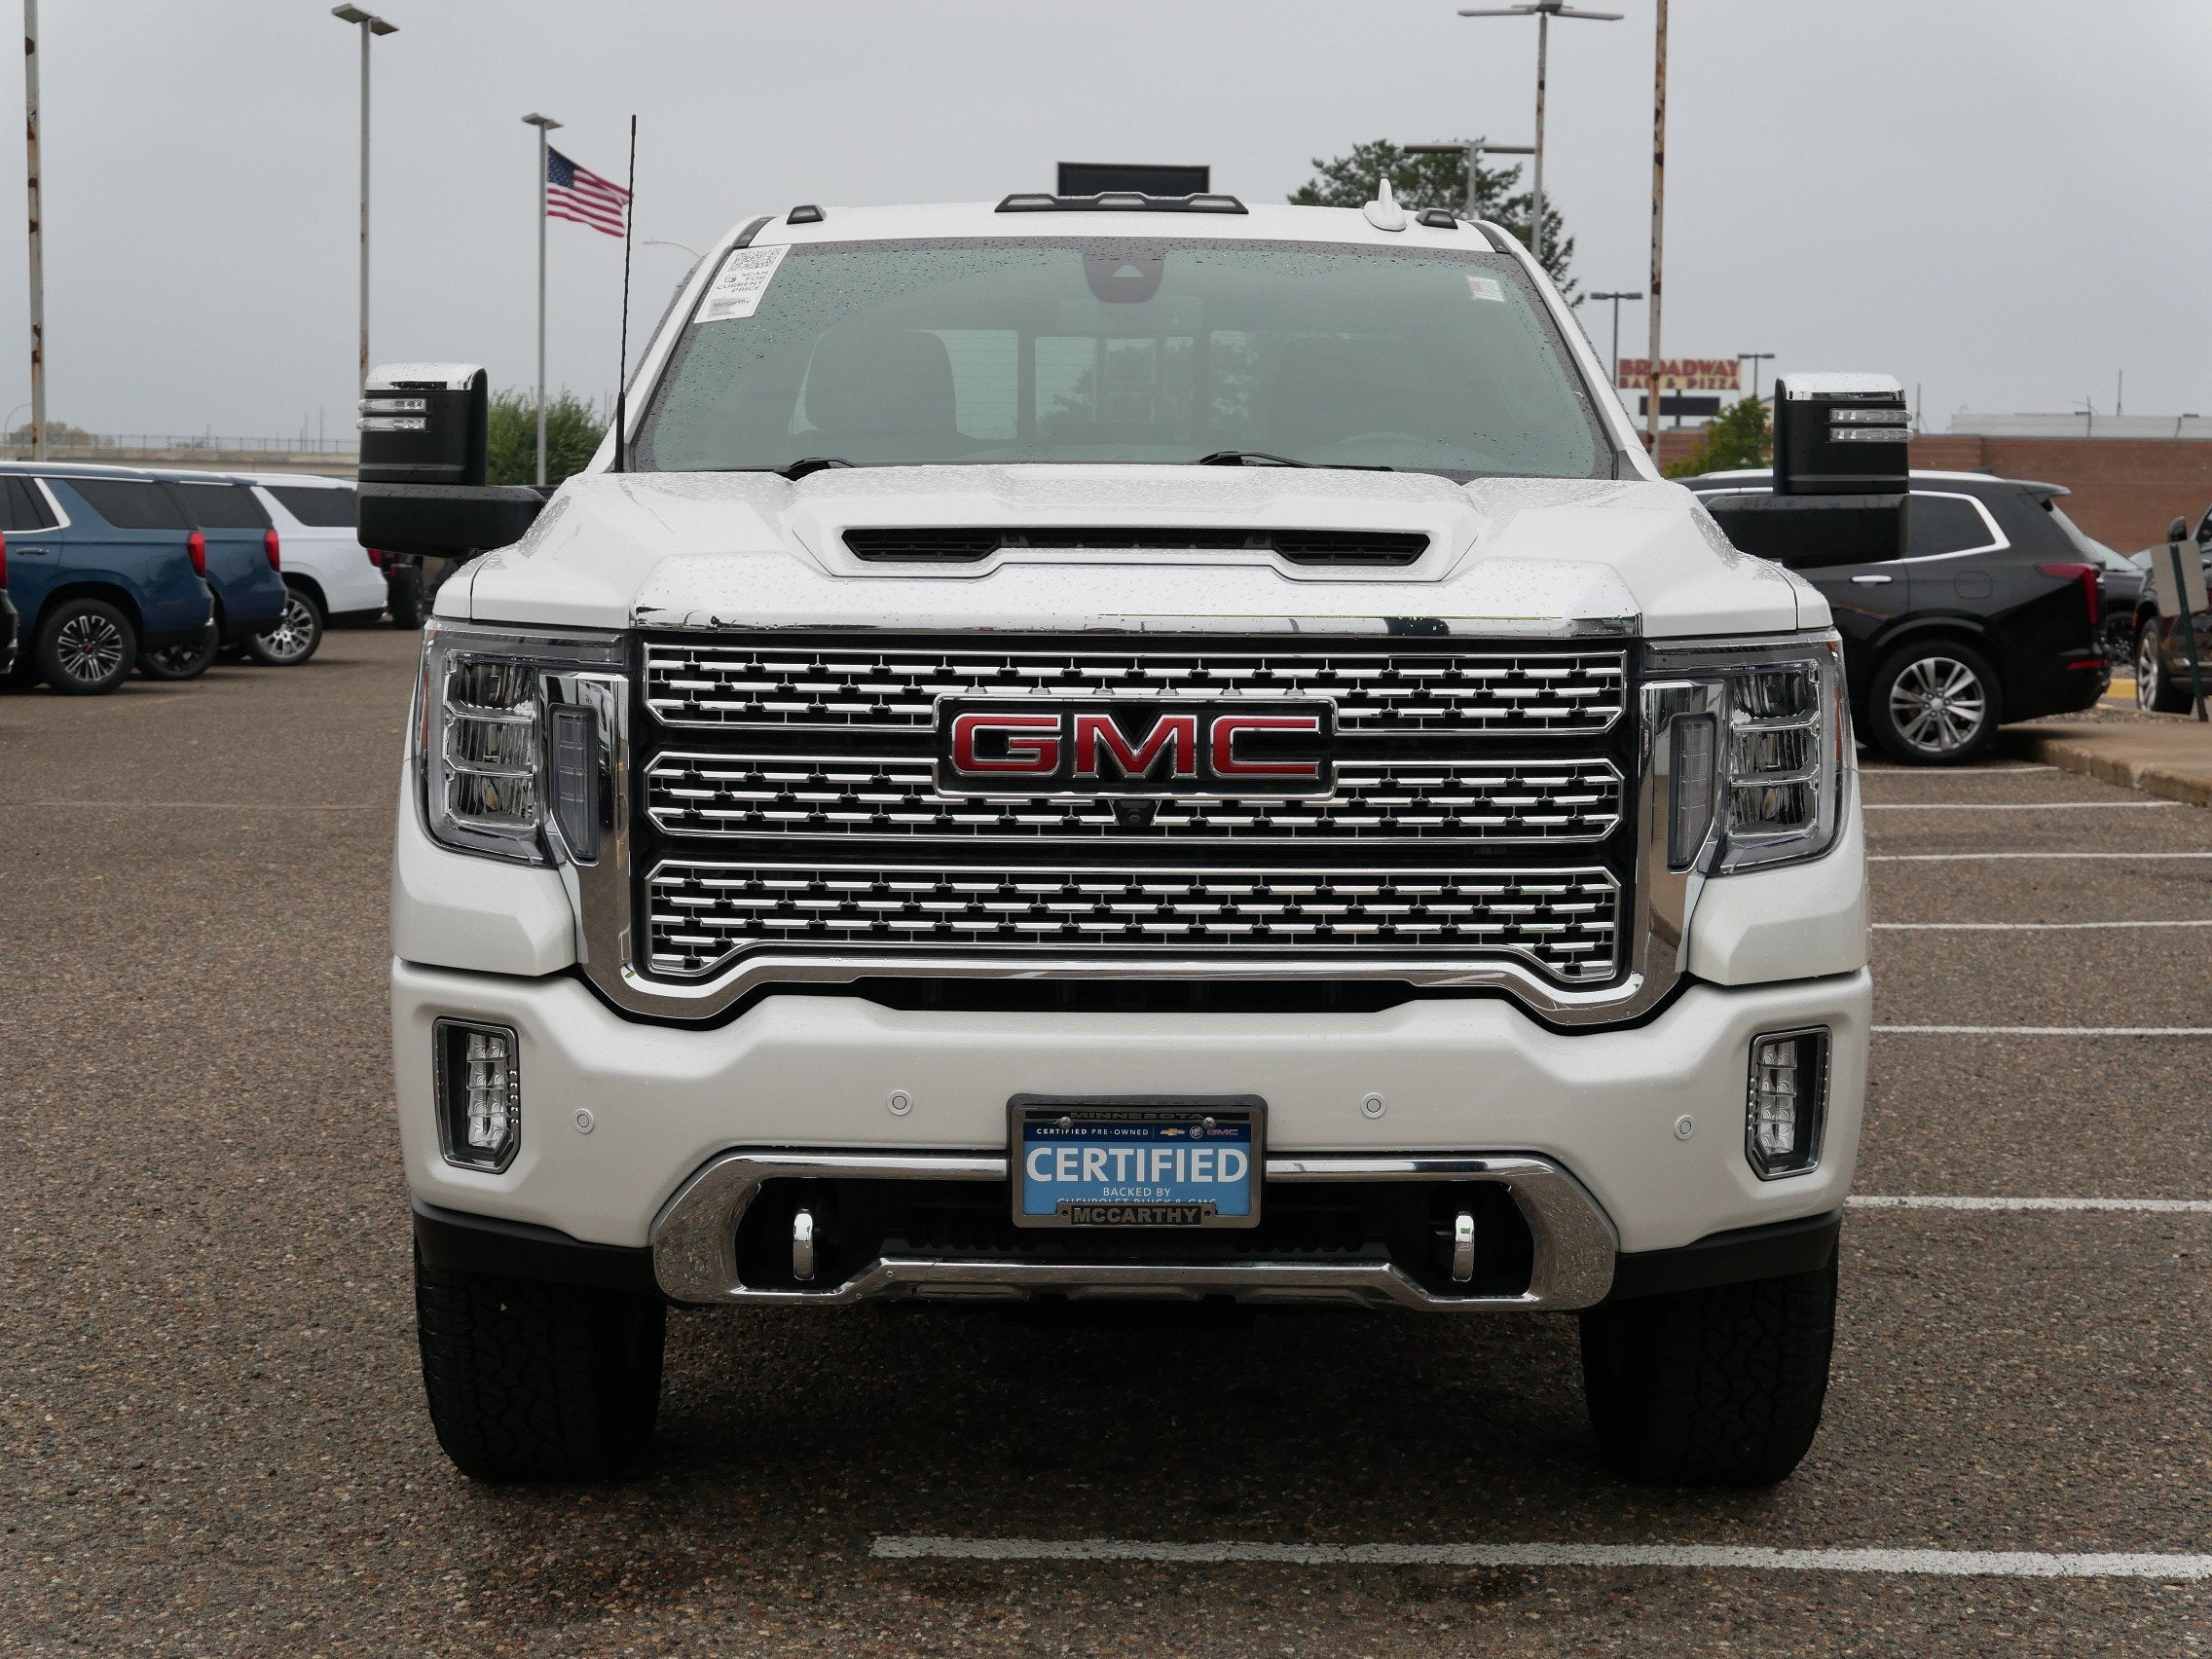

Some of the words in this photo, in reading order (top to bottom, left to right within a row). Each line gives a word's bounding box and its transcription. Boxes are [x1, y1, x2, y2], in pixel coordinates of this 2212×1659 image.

[1685, 378, 1741, 389] PIZZA
[951, 713, 1321, 779] GMC
[1026, 1147, 1248, 1183] CERTIFIED
[1103, 1187, 1152, 1197] BACKED
[1157, 1187, 1171, 1197] BY
[1074, 1207, 1198, 1223] MCCARTHY
